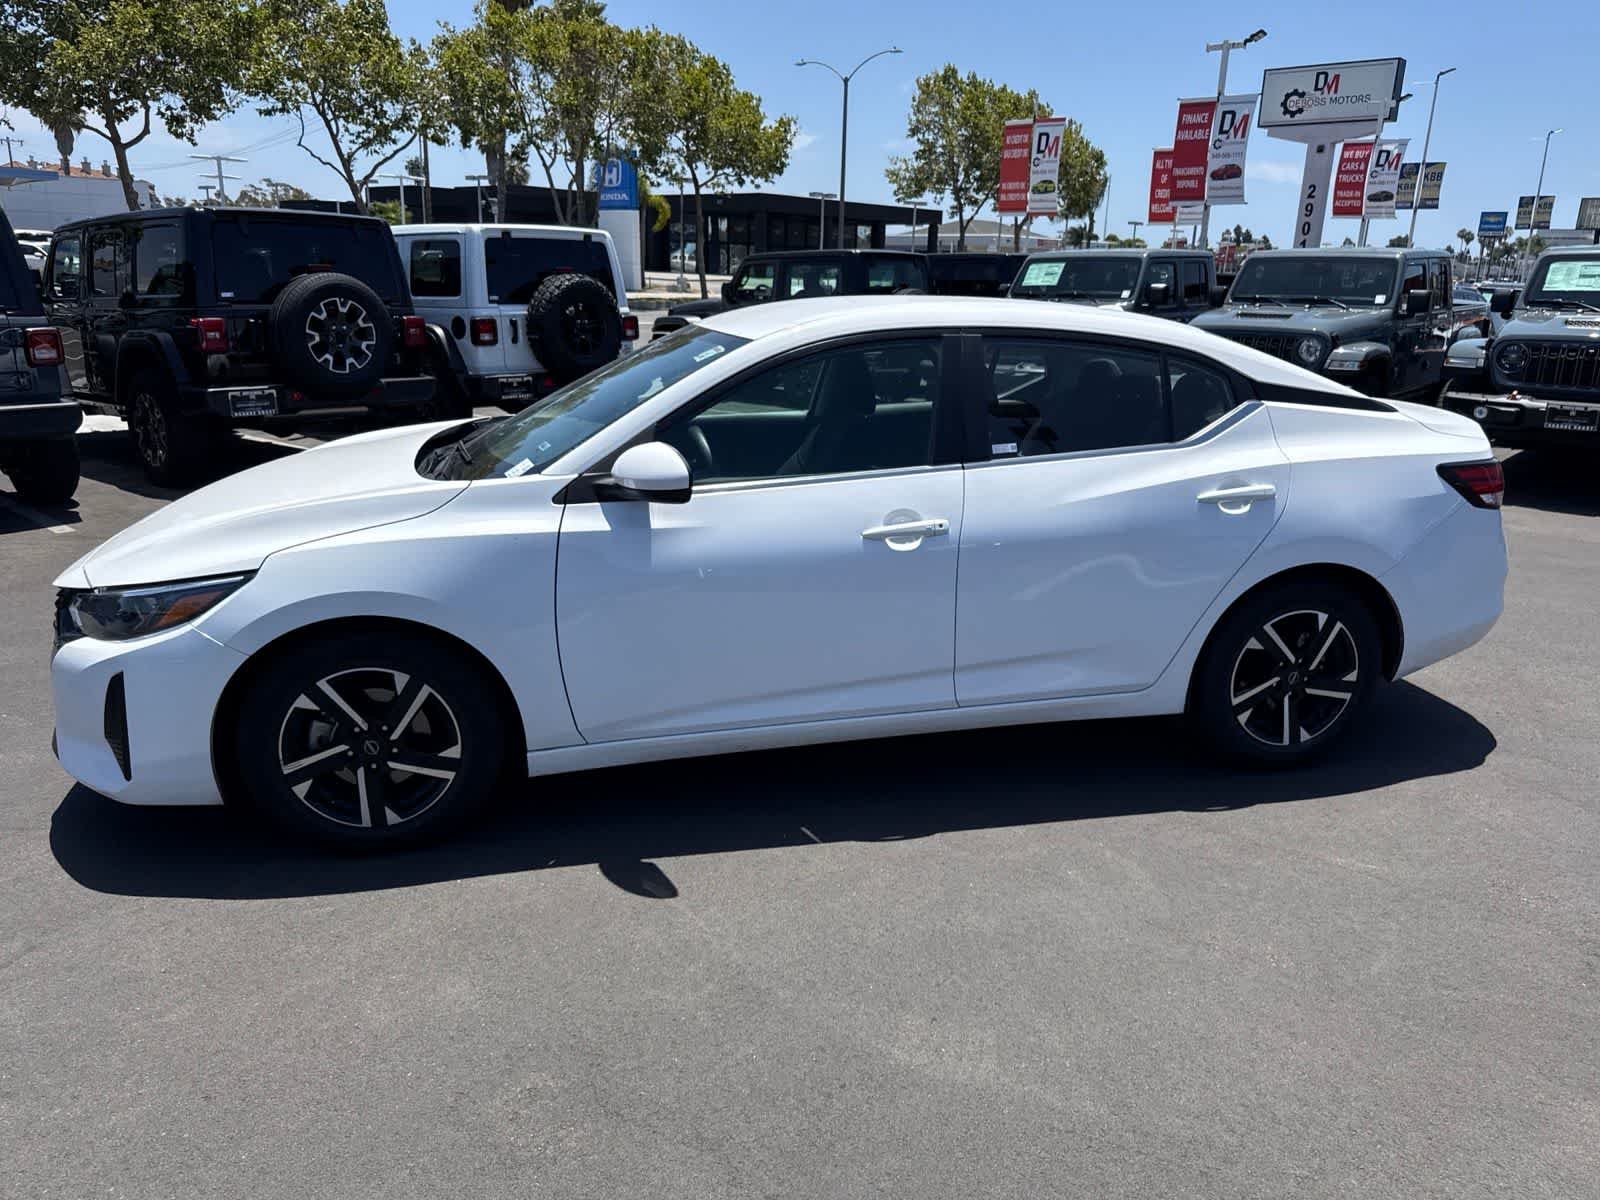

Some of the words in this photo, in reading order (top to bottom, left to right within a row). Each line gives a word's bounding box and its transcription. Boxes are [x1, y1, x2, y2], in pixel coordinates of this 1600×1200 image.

[1329, 94, 1372, 105] MOTORS
[1182, 112, 1209, 125] FINANCE
[1177, 128, 1210, 140] AVAILABLE
[1343, 150, 1356, 159] WE
[1356, 149, 1369, 159] BUY
[1341, 162, 1359, 171] CARS
[1160, 174, 1168, 184] OF
[1338, 174, 1365, 183] TRUCKS
